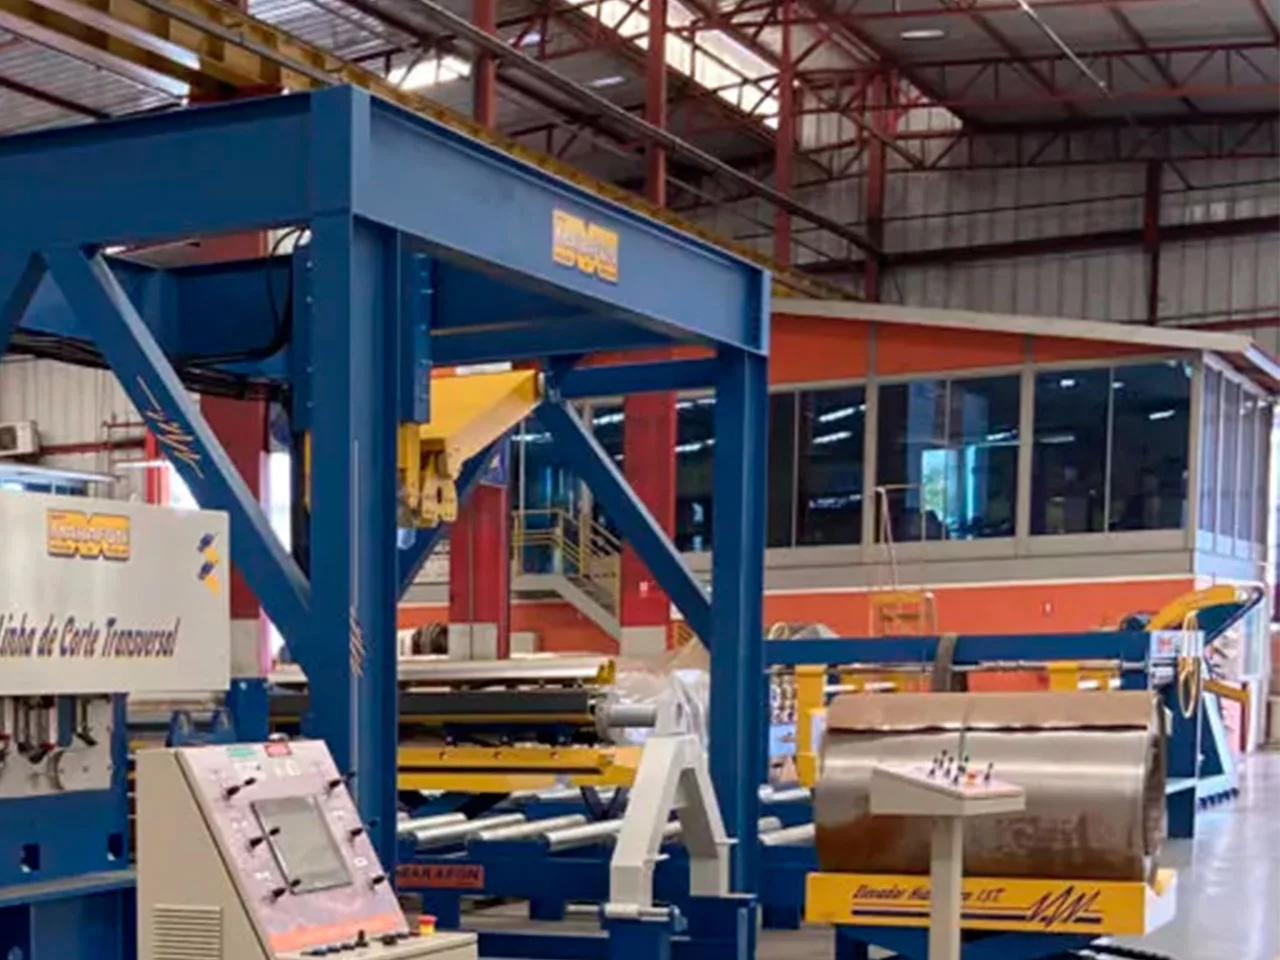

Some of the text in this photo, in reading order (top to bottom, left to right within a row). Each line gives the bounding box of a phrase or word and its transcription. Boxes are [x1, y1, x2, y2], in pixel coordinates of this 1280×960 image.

[37, 613, 58, 657] de
[60, 615, 100, 657] Corte
[102, 616, 181, 657] Transversal
